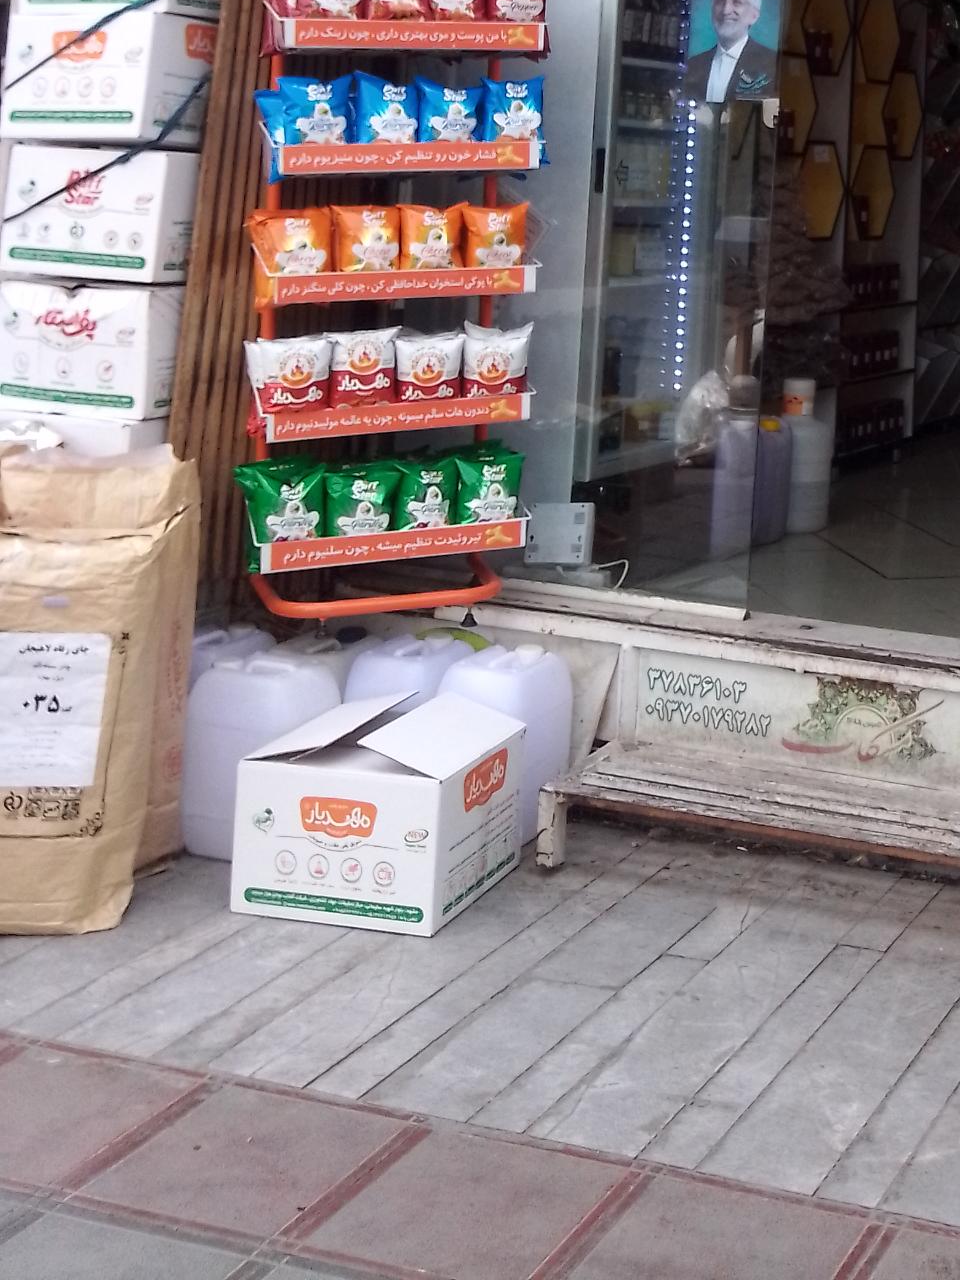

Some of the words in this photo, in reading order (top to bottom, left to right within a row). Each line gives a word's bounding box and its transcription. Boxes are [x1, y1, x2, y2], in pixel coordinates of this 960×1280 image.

[646, 666, 748, 704] ۳۷۸۳۶۱۰۳
[645, 697, 772, 738] ۰۹۳۷۰۱۷۹۲۸۲
[304, 801, 371, 829] مهدیار
